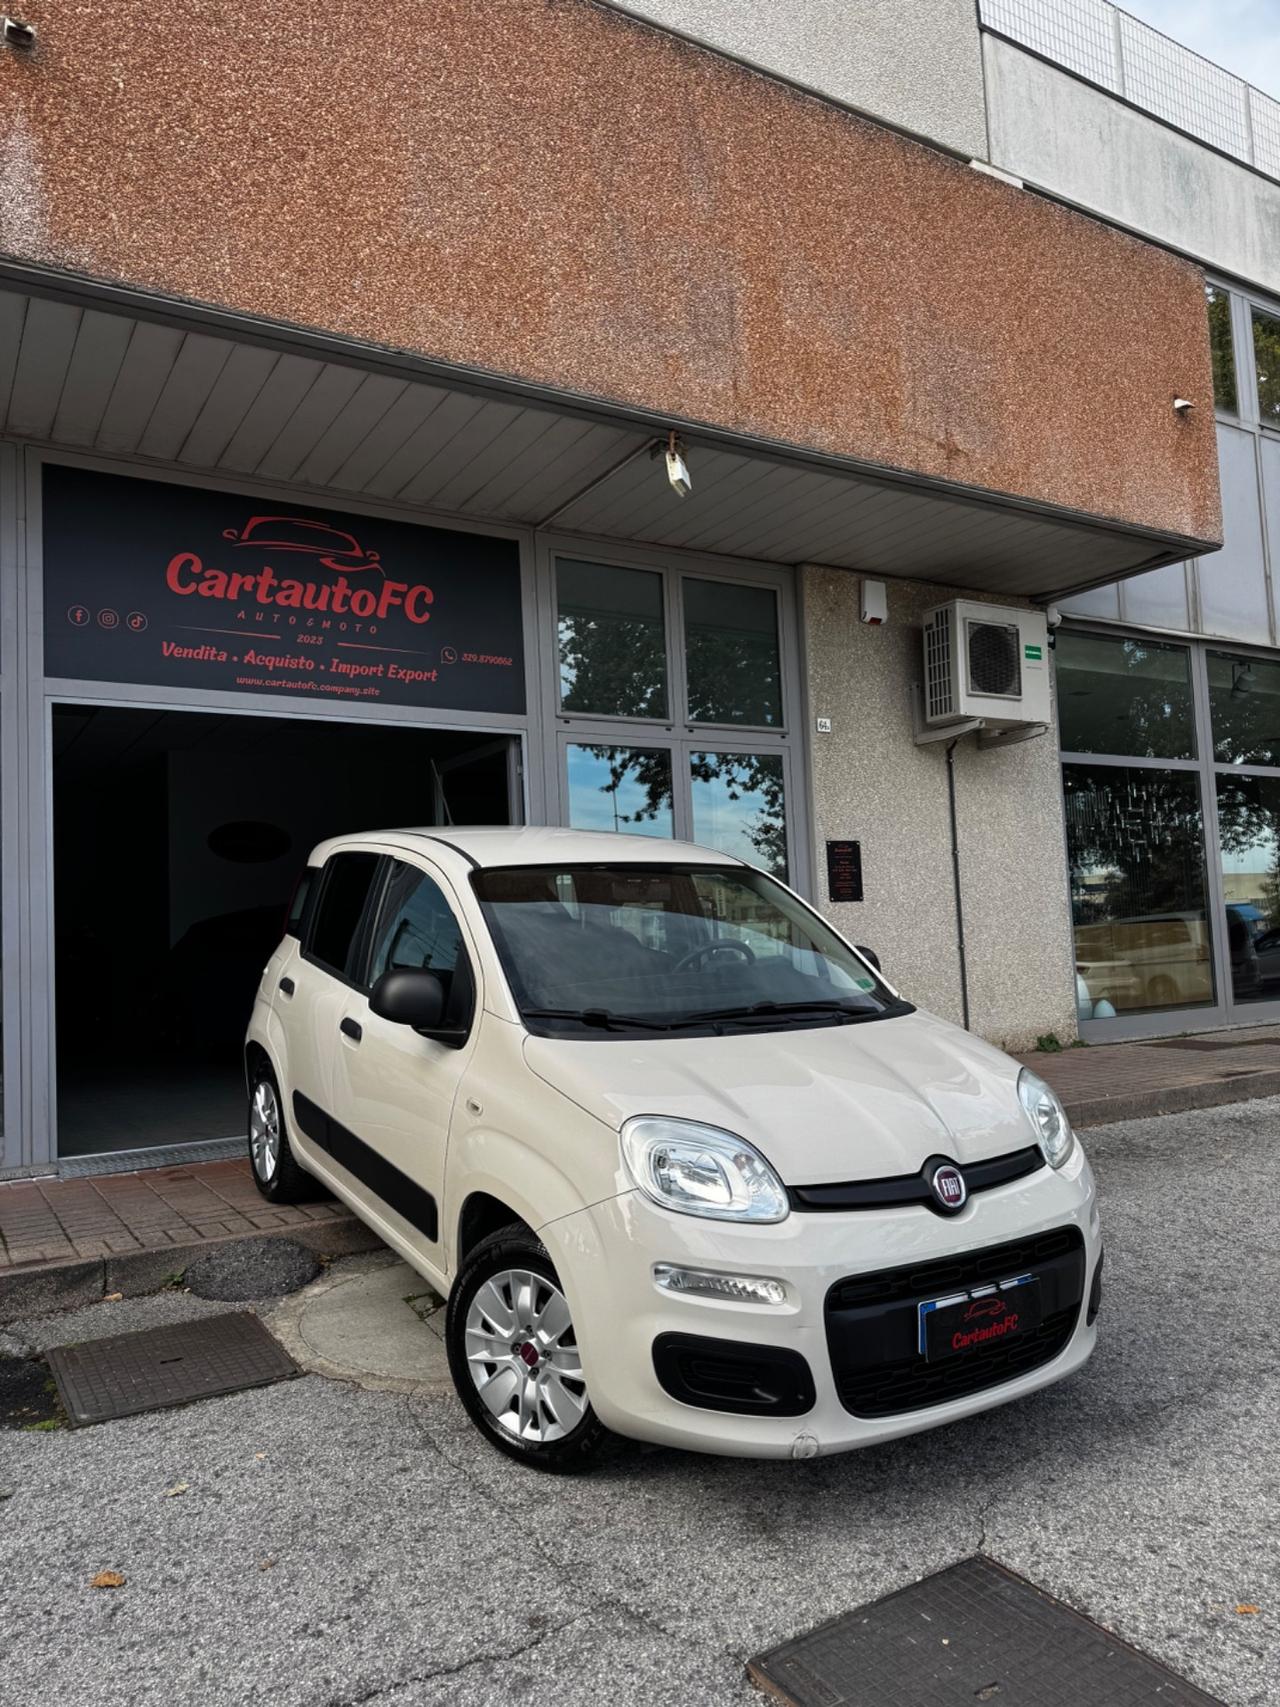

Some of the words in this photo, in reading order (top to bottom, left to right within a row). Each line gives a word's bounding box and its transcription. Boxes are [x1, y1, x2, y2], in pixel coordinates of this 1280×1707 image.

[166, 553, 434, 624] CartautoFC
[161, 641, 228, 662] Vendita
[243, 649, 315, 671] Acquisto
[329, 657, 384, 678] Import
[387, 663, 439, 683] Export
[236, 676, 380, 696] www.cartautofc.company.site
[941, 1177, 960, 1196] FIAT
[952, 1314, 1018, 1349] CartautoFC
